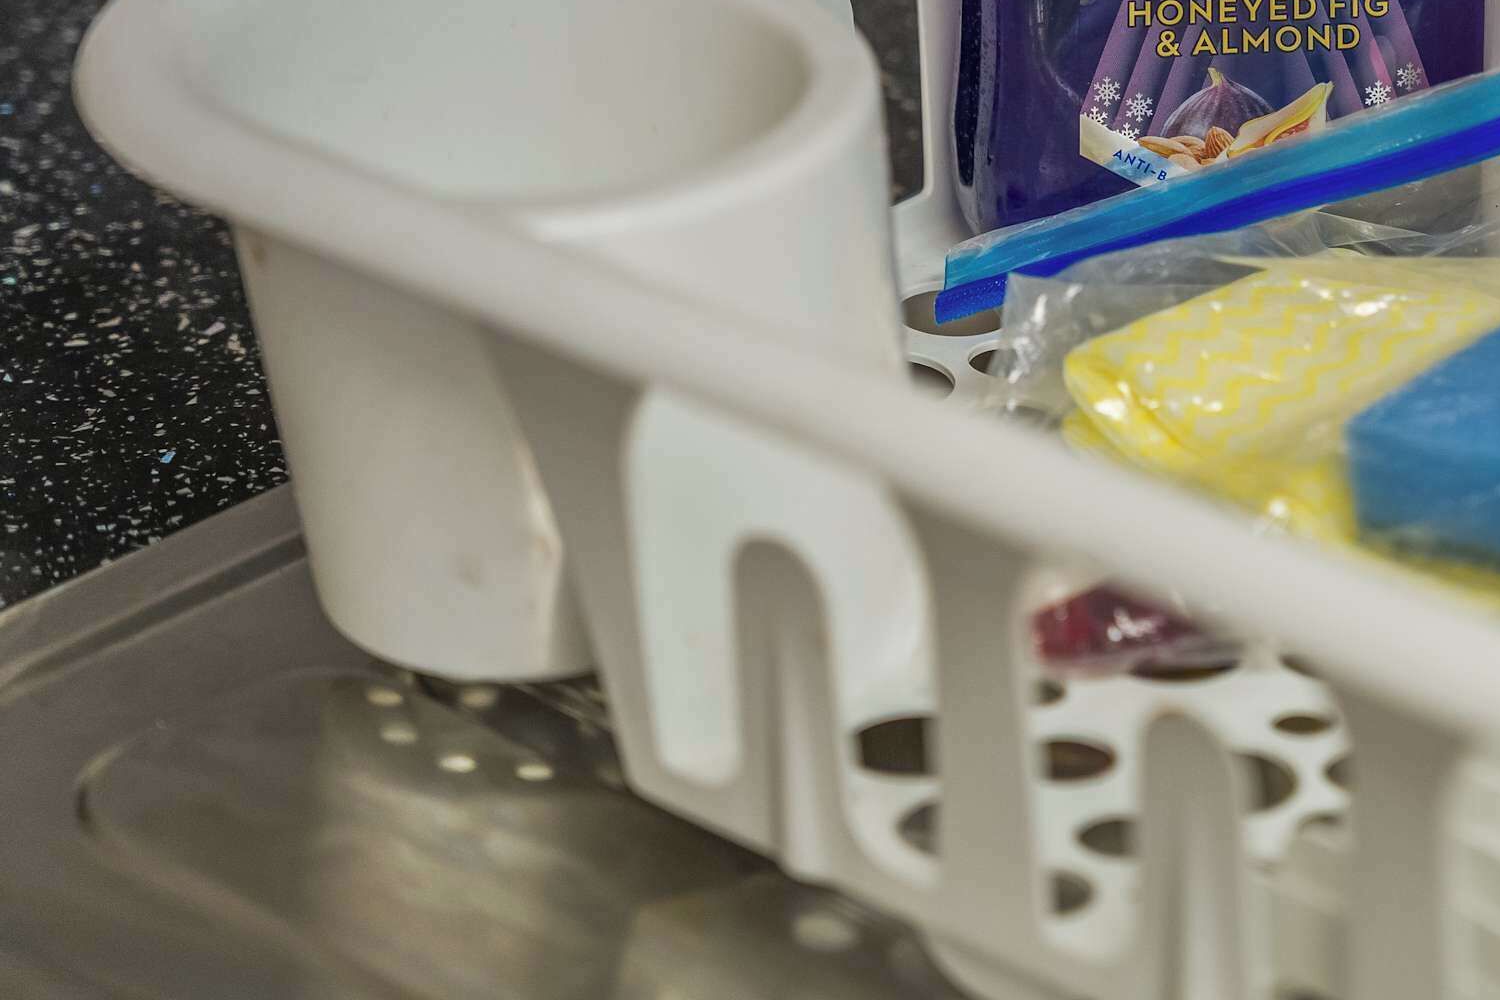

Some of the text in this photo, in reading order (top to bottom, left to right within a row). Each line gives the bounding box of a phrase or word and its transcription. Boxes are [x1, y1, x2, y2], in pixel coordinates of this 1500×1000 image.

[1156, 23, 1361, 57] & ALMOND
[1112, 149, 1167, 181] ANTI-B
